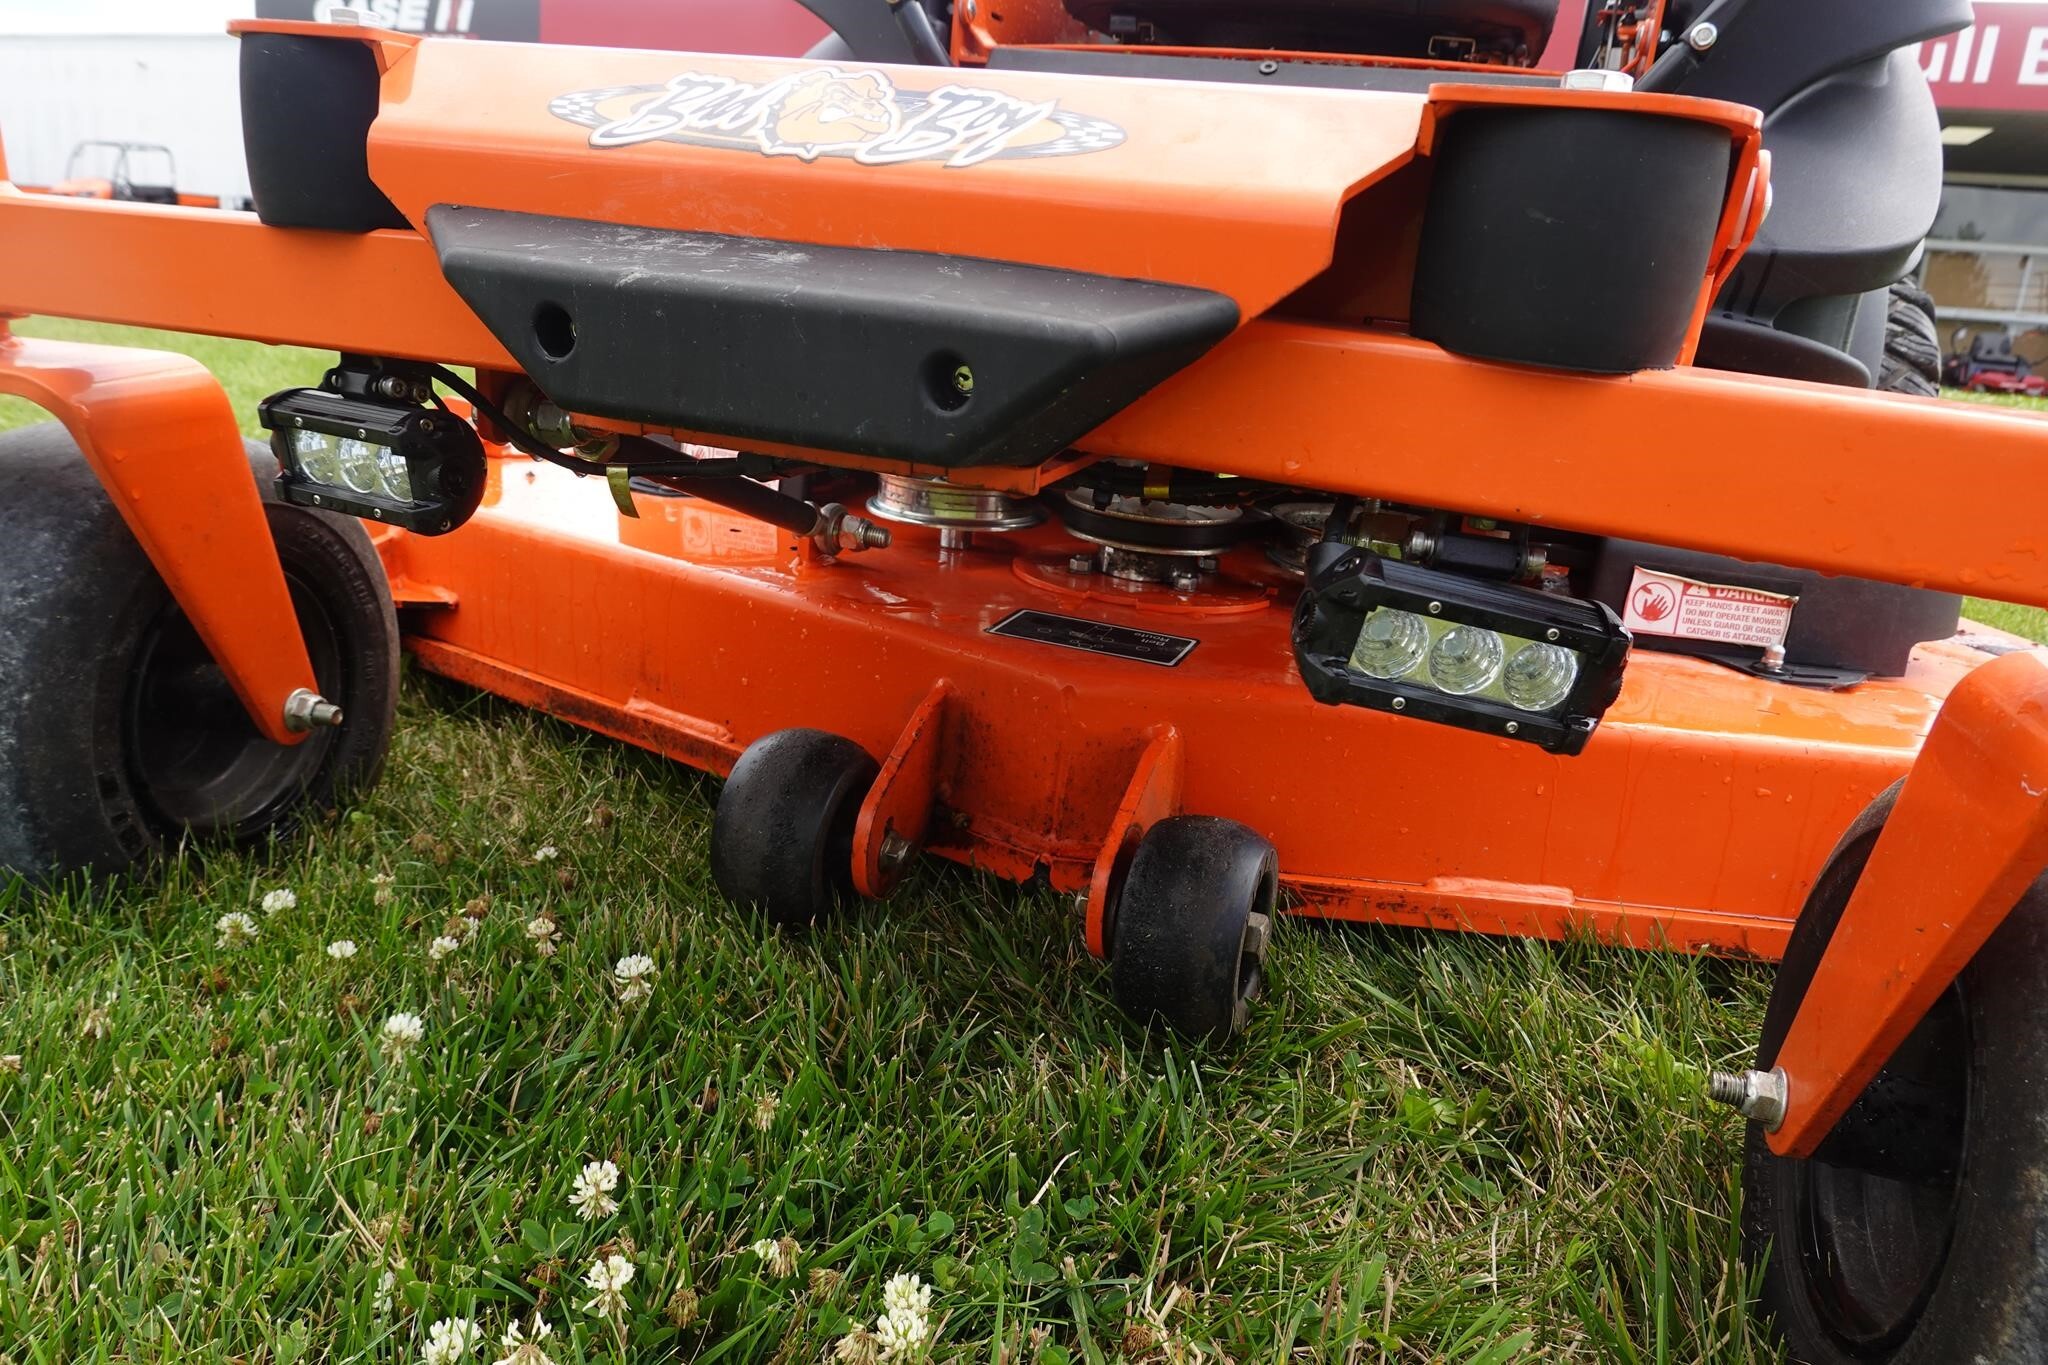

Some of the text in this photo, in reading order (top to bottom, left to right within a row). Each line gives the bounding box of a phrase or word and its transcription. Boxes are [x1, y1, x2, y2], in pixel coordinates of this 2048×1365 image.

[854, 84, 1058, 168] Boy
[1685, 598, 1705, 608] KEEP
[1706, 600, 1733, 611] HANDS
[1742, 605, 1760, 615] FEET
[1698, 609, 1714, 618] NOT
[1716, 611, 1750, 623] OPERATE
[1682, 617, 1782, 636] UNLESS GUARD OR GRASS
[1686, 627, 1721, 637] CATCHER
